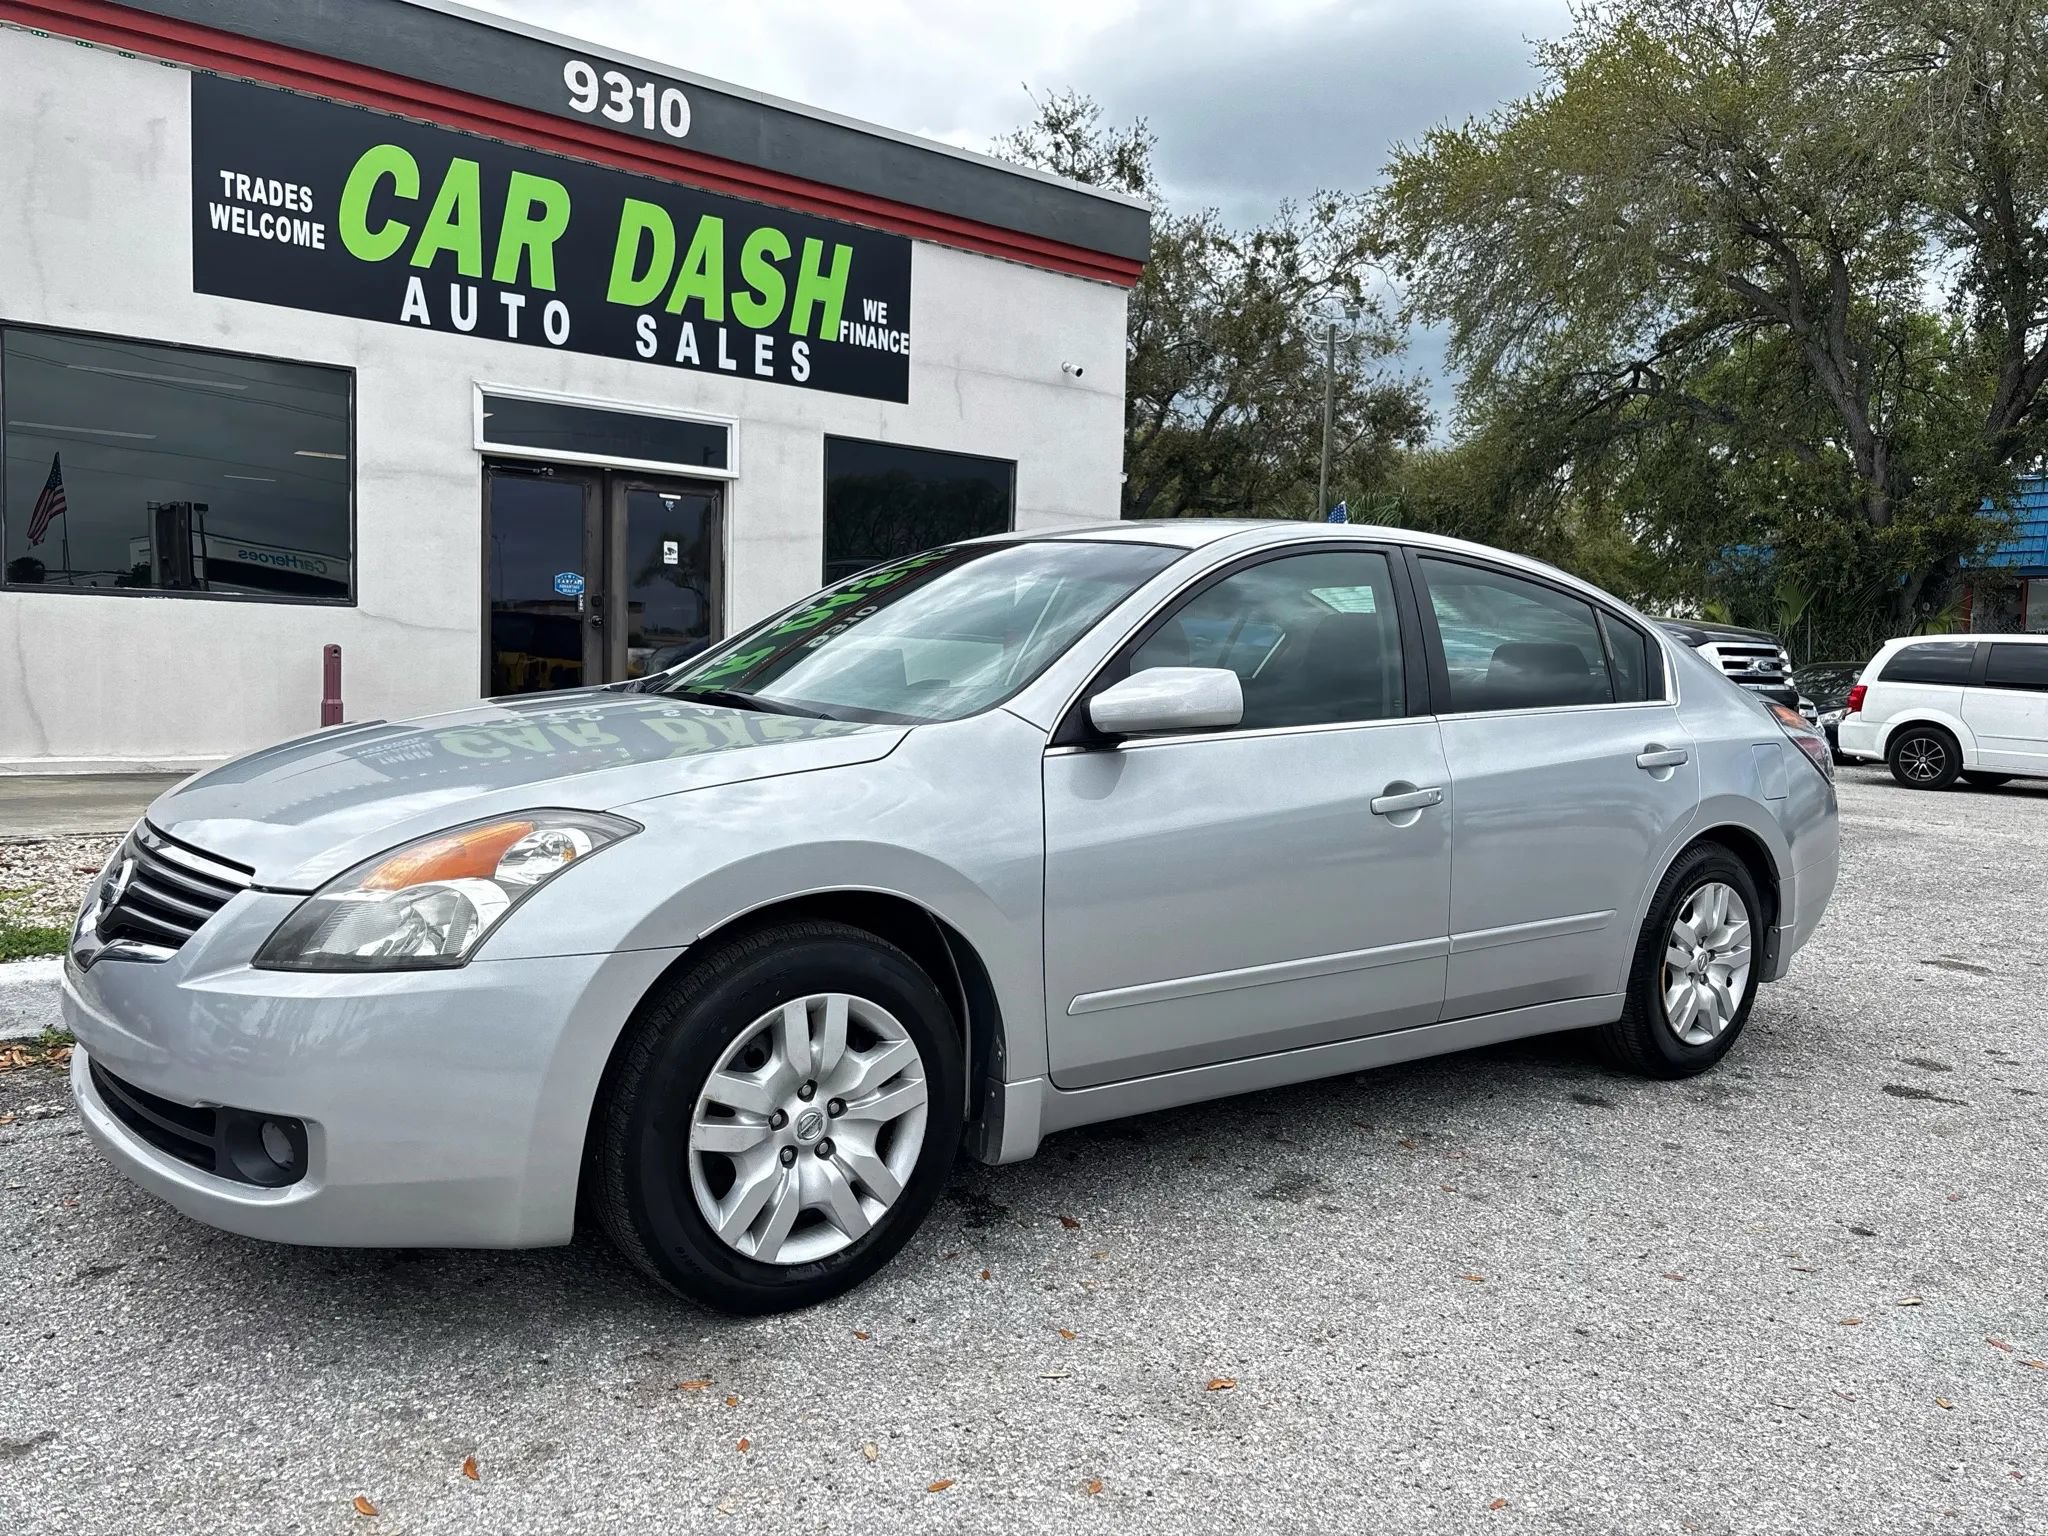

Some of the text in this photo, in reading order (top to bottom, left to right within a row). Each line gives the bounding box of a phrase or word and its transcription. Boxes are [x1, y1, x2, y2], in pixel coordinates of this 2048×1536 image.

[563, 60, 691, 138] 9310
[220, 170, 313, 213] TRADES
[209, 202, 326, 250] WELCOME
[339, 143, 854, 342] CAR DASH
[400, 275, 811, 382] AUTO SALES
[863, 298, 888, 325] WE
[840, 320, 910, 355] FINANCE
